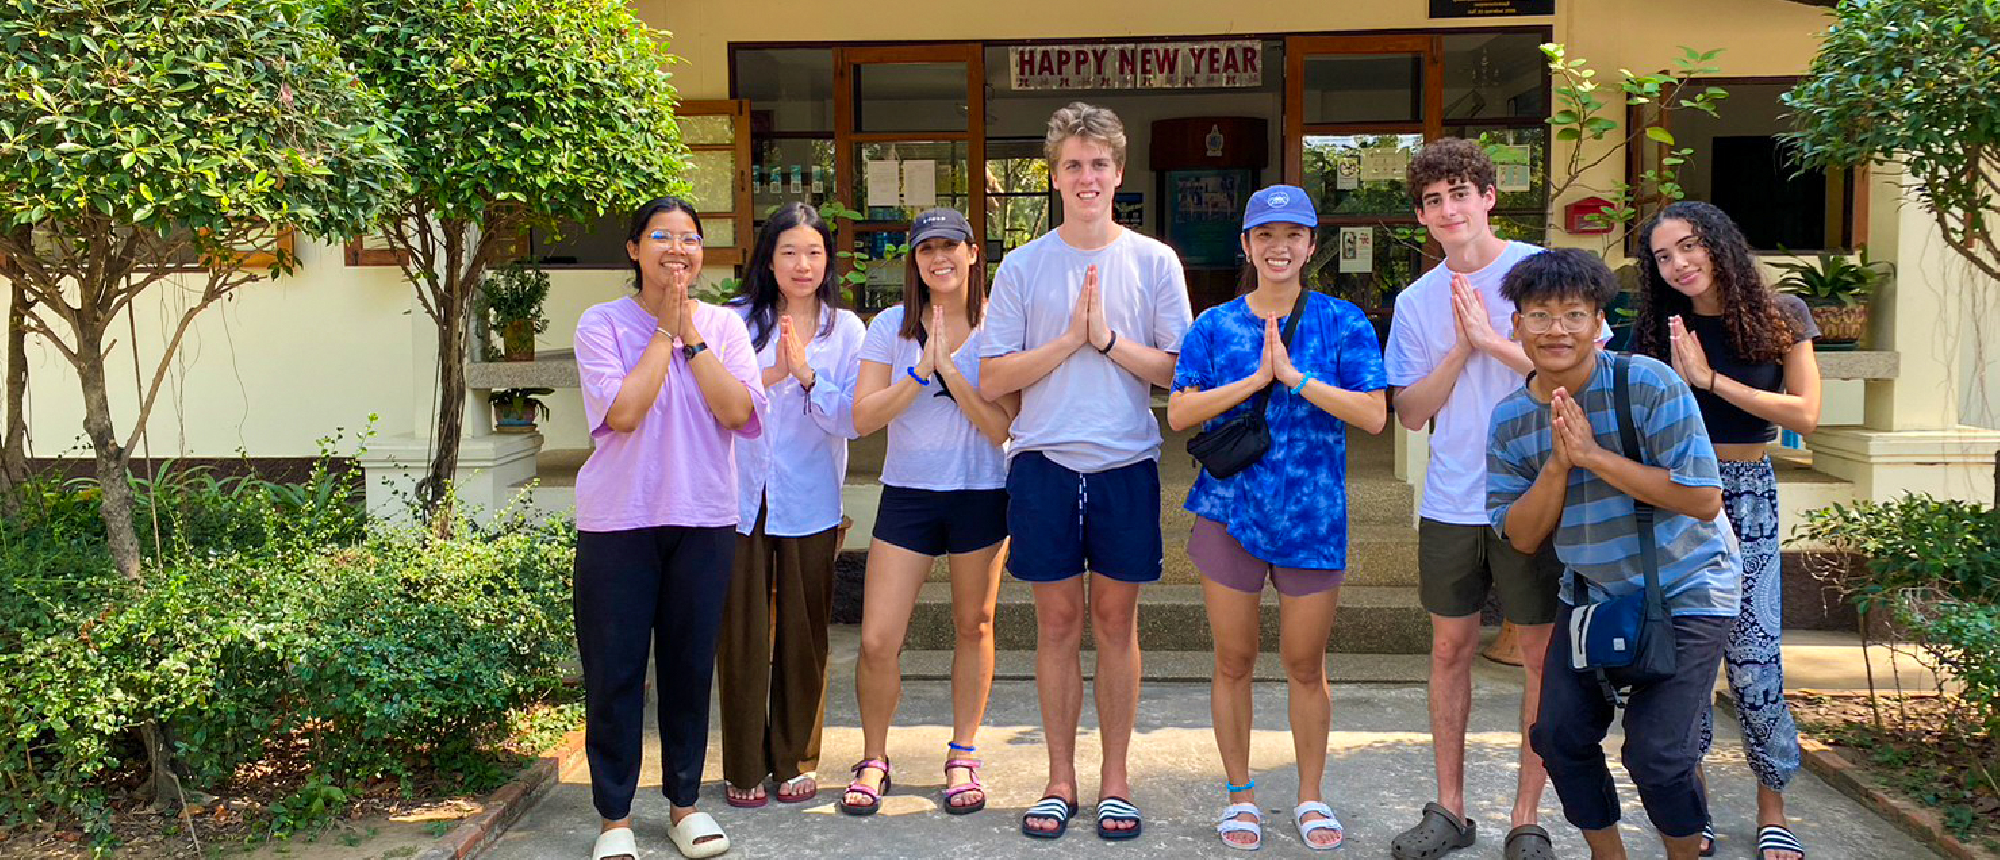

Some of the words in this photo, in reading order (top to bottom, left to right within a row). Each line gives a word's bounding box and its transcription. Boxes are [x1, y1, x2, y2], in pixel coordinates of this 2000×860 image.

[1018, 49, 1108, 76] HAPPY
[1118, 46, 1180, 75] NEW
[1189, 45, 1258, 74] YEAR
